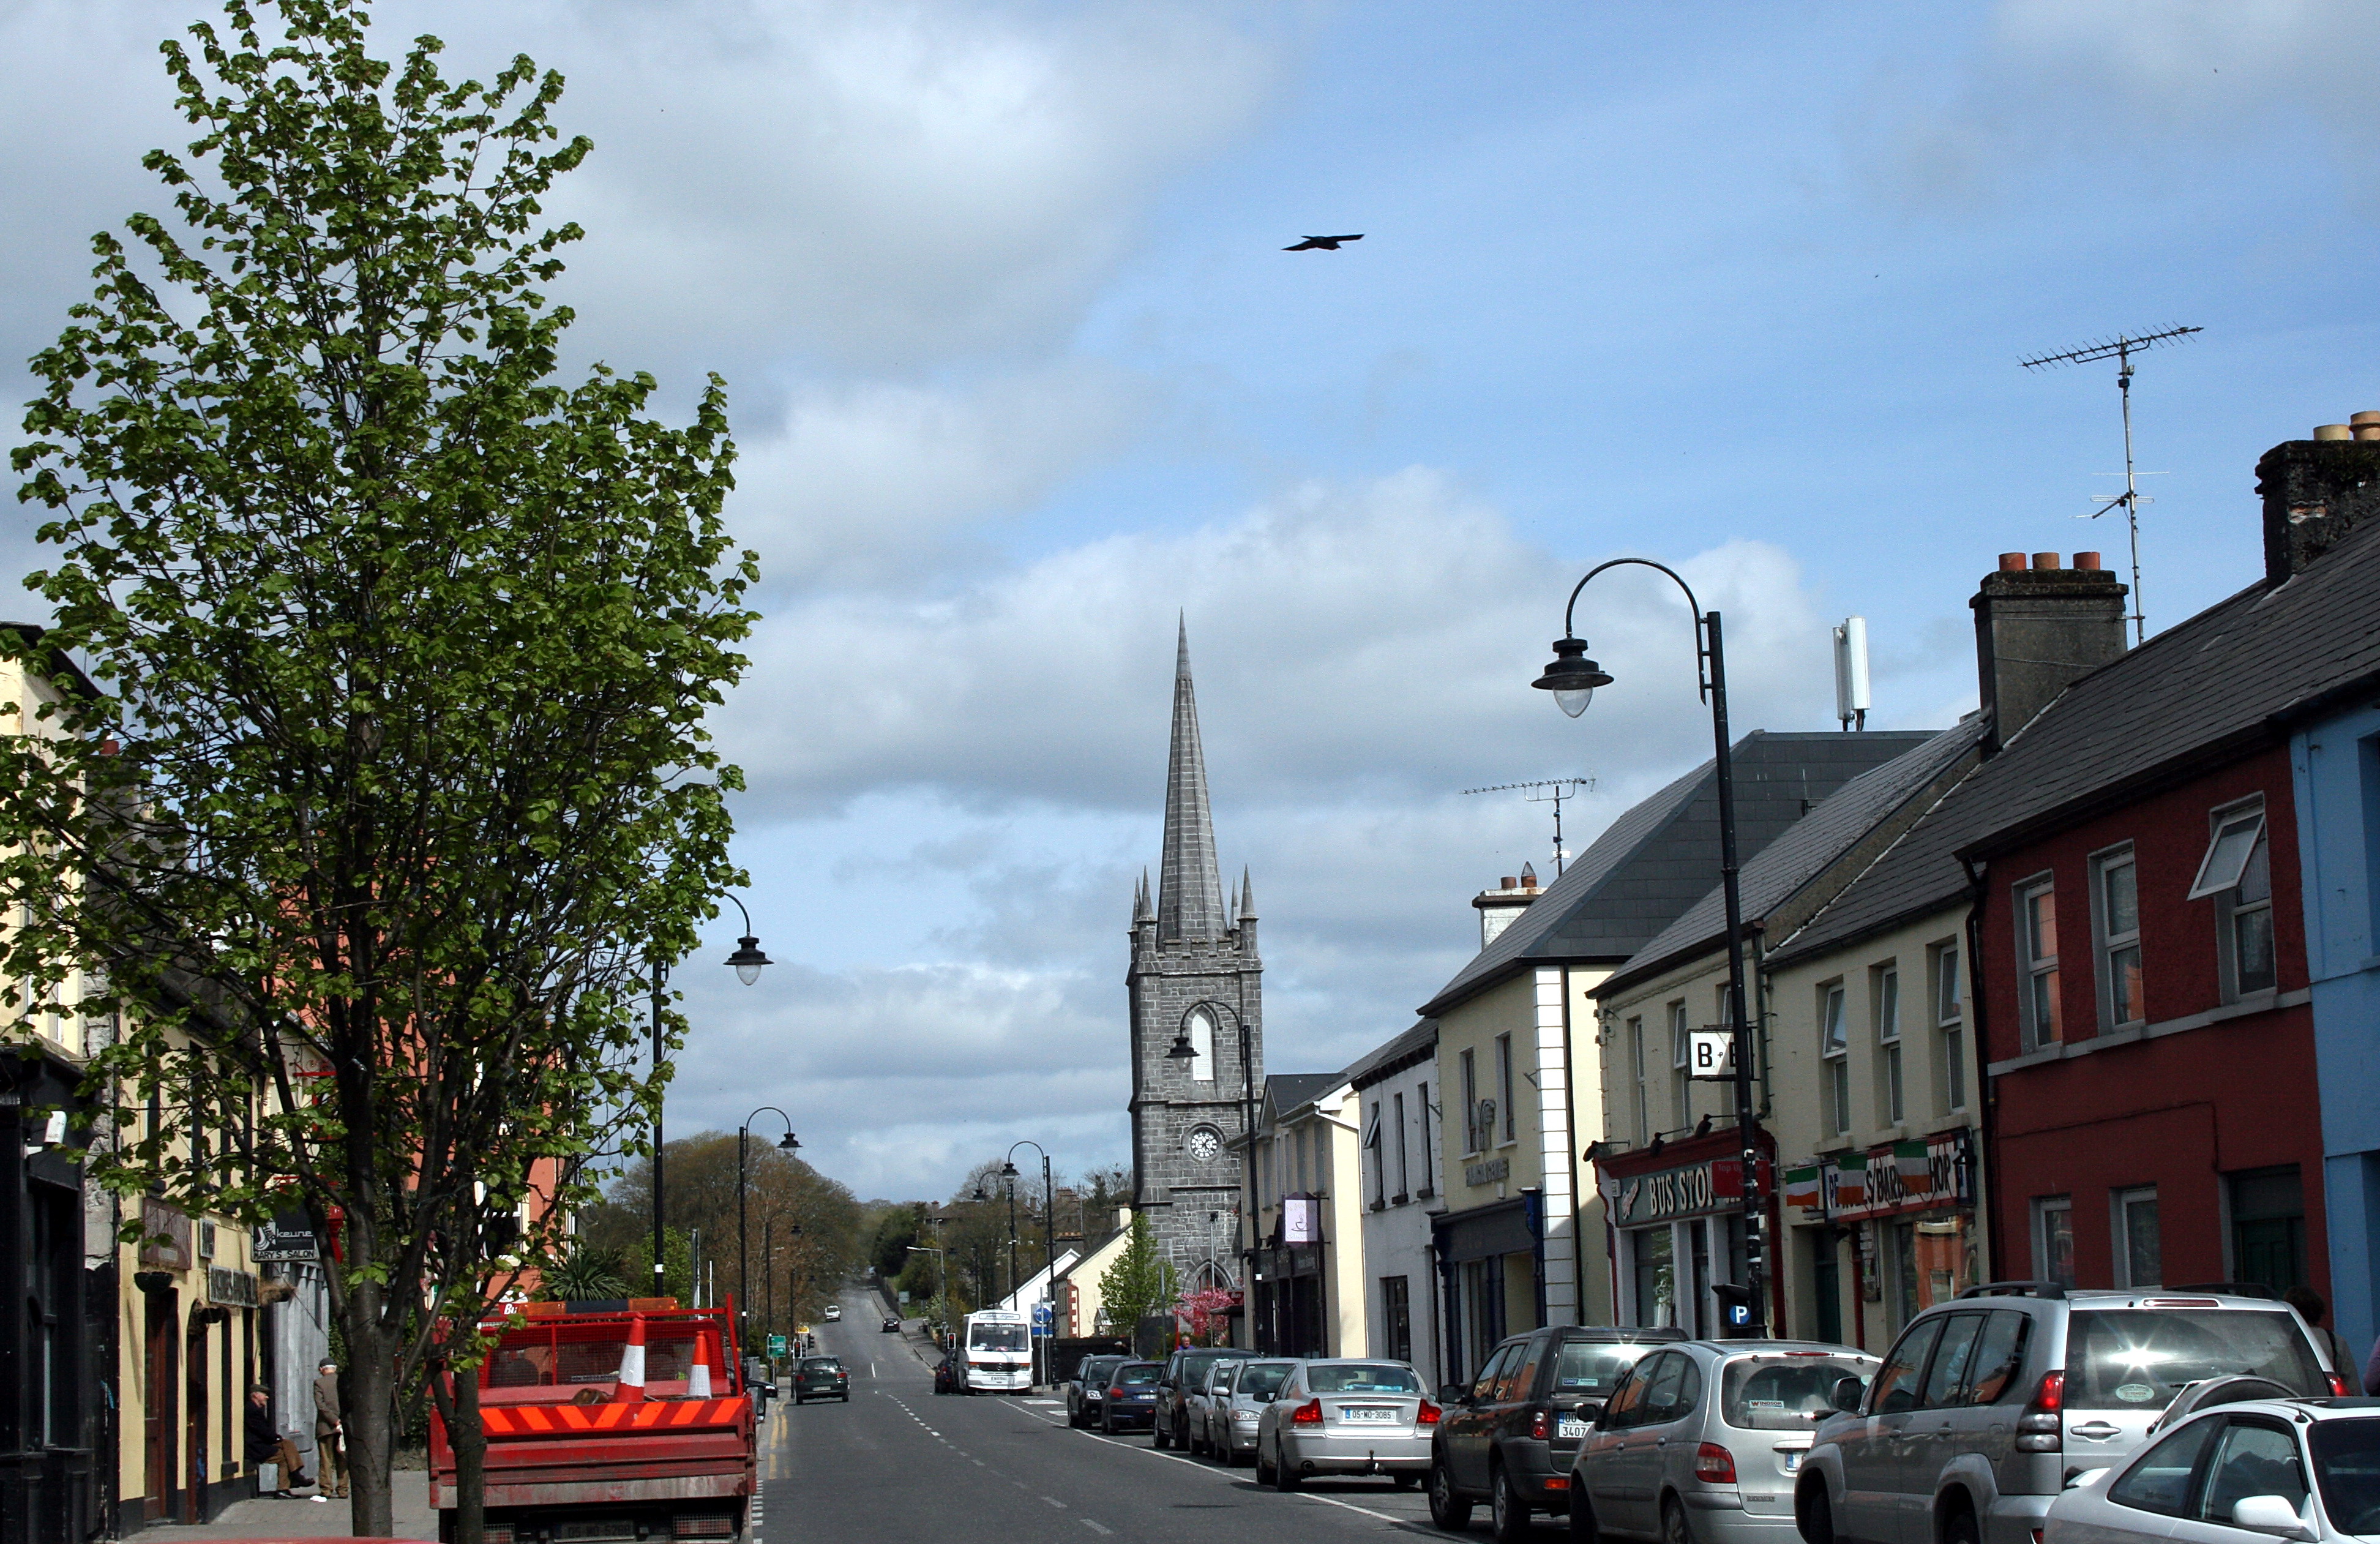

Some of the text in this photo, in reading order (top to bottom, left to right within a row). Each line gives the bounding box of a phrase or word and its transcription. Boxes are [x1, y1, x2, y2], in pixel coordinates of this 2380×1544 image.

[1928, 1153, 1951, 1193] HOP
[1648, 1173, 1674, 1216] BUS
[1735, 1306, 1748, 1324] P
[1352, 1411, 1391, 1419] 05-MO-3085
